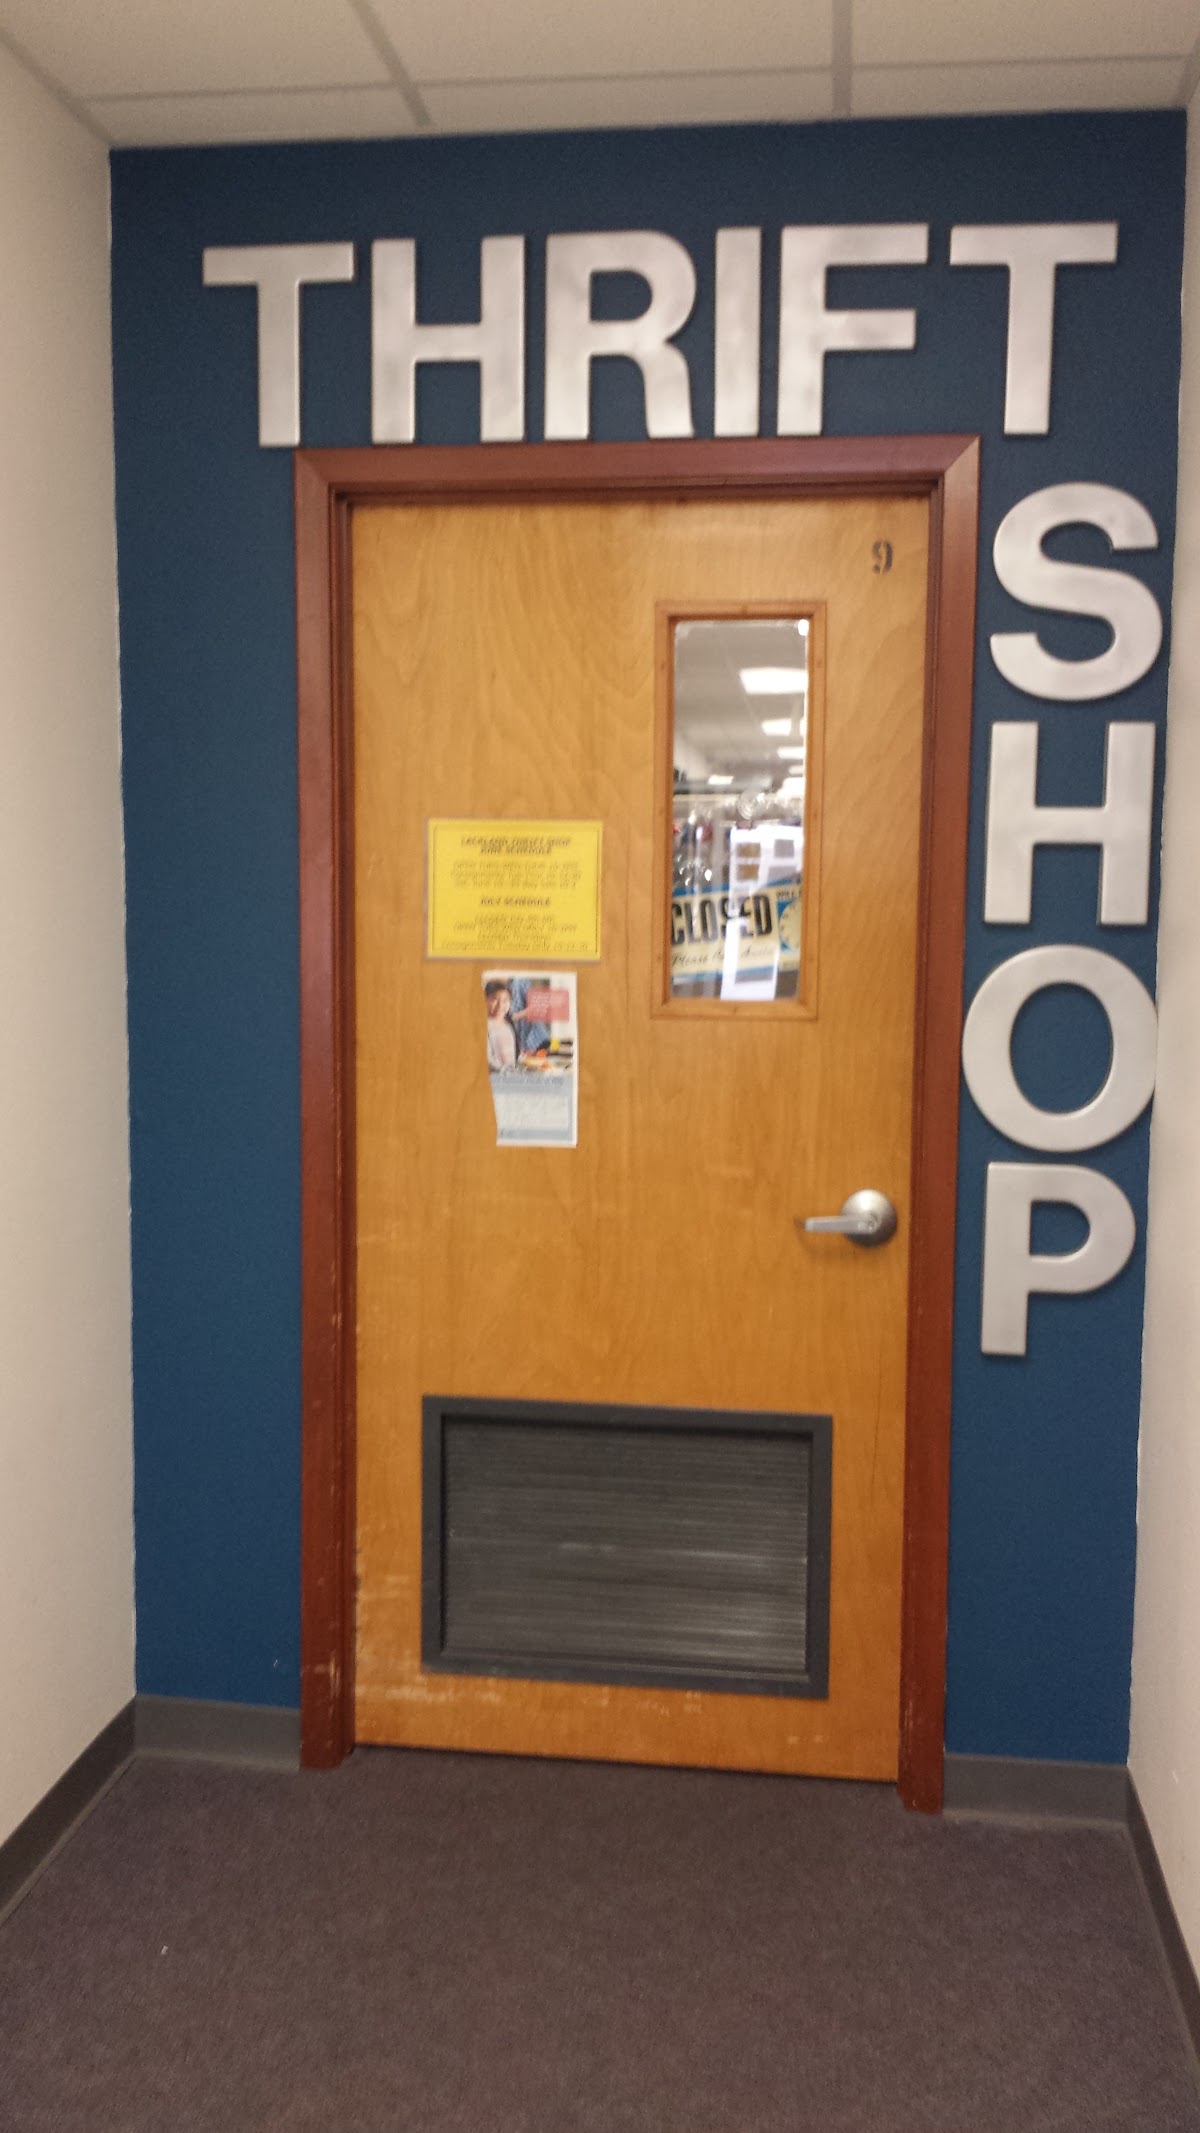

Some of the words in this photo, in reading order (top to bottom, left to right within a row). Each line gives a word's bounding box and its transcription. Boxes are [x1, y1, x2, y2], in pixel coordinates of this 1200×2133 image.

[202, 221, 1119, 448] THRIFT
[872, 540, 893, 574] 9
[671, 894, 773, 945] CLOSED
[961, 481, 1164, 1357] SHOP
